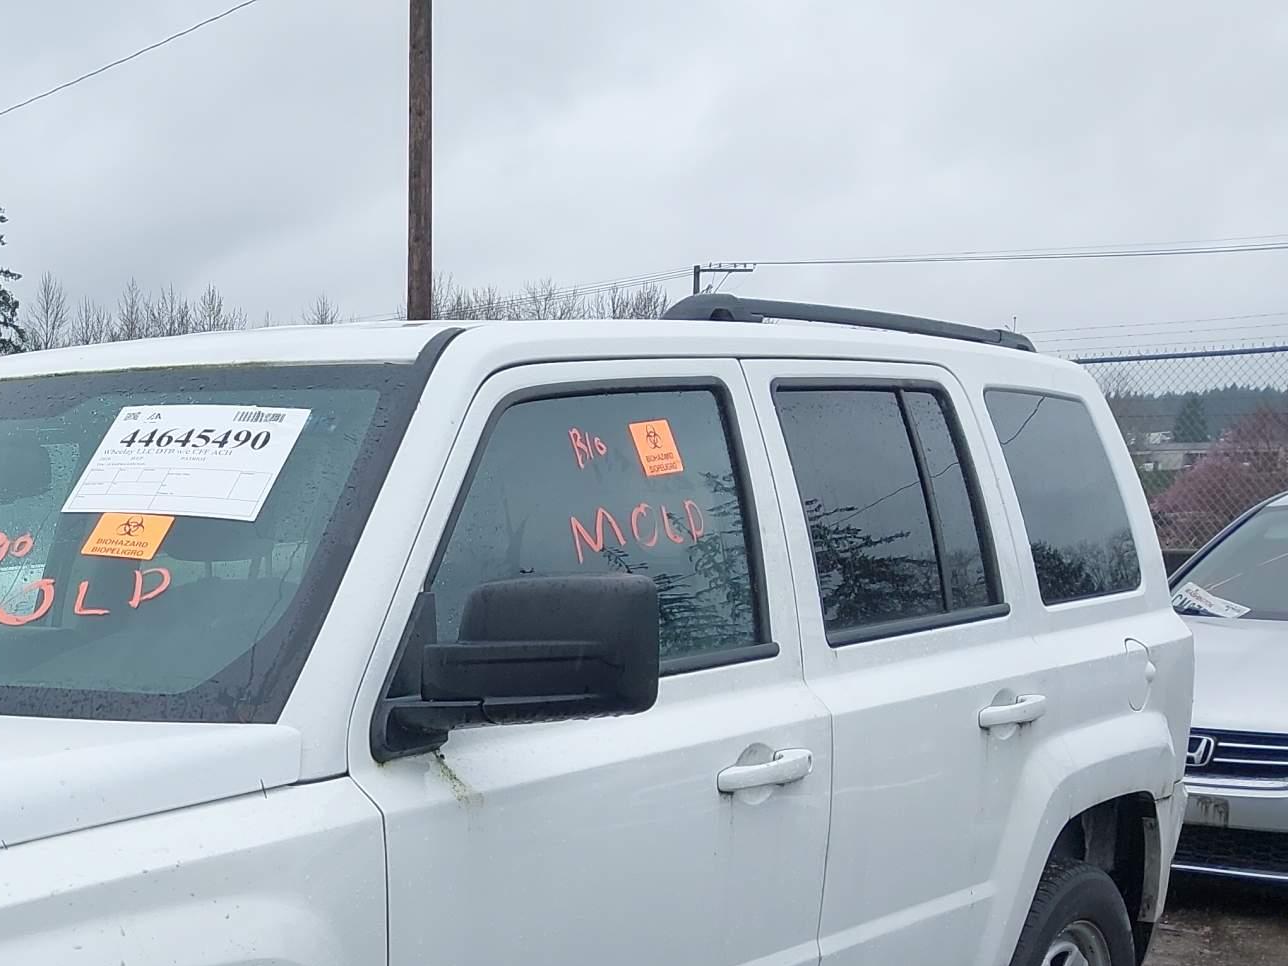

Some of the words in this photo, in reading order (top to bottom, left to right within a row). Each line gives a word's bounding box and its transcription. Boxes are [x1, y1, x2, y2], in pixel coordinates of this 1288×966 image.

[120, 428, 272, 450] 44645490
[96, 538, 149, 547] BIOHAZARD
[91, 546, 144, 556] BIOPELIGRO
